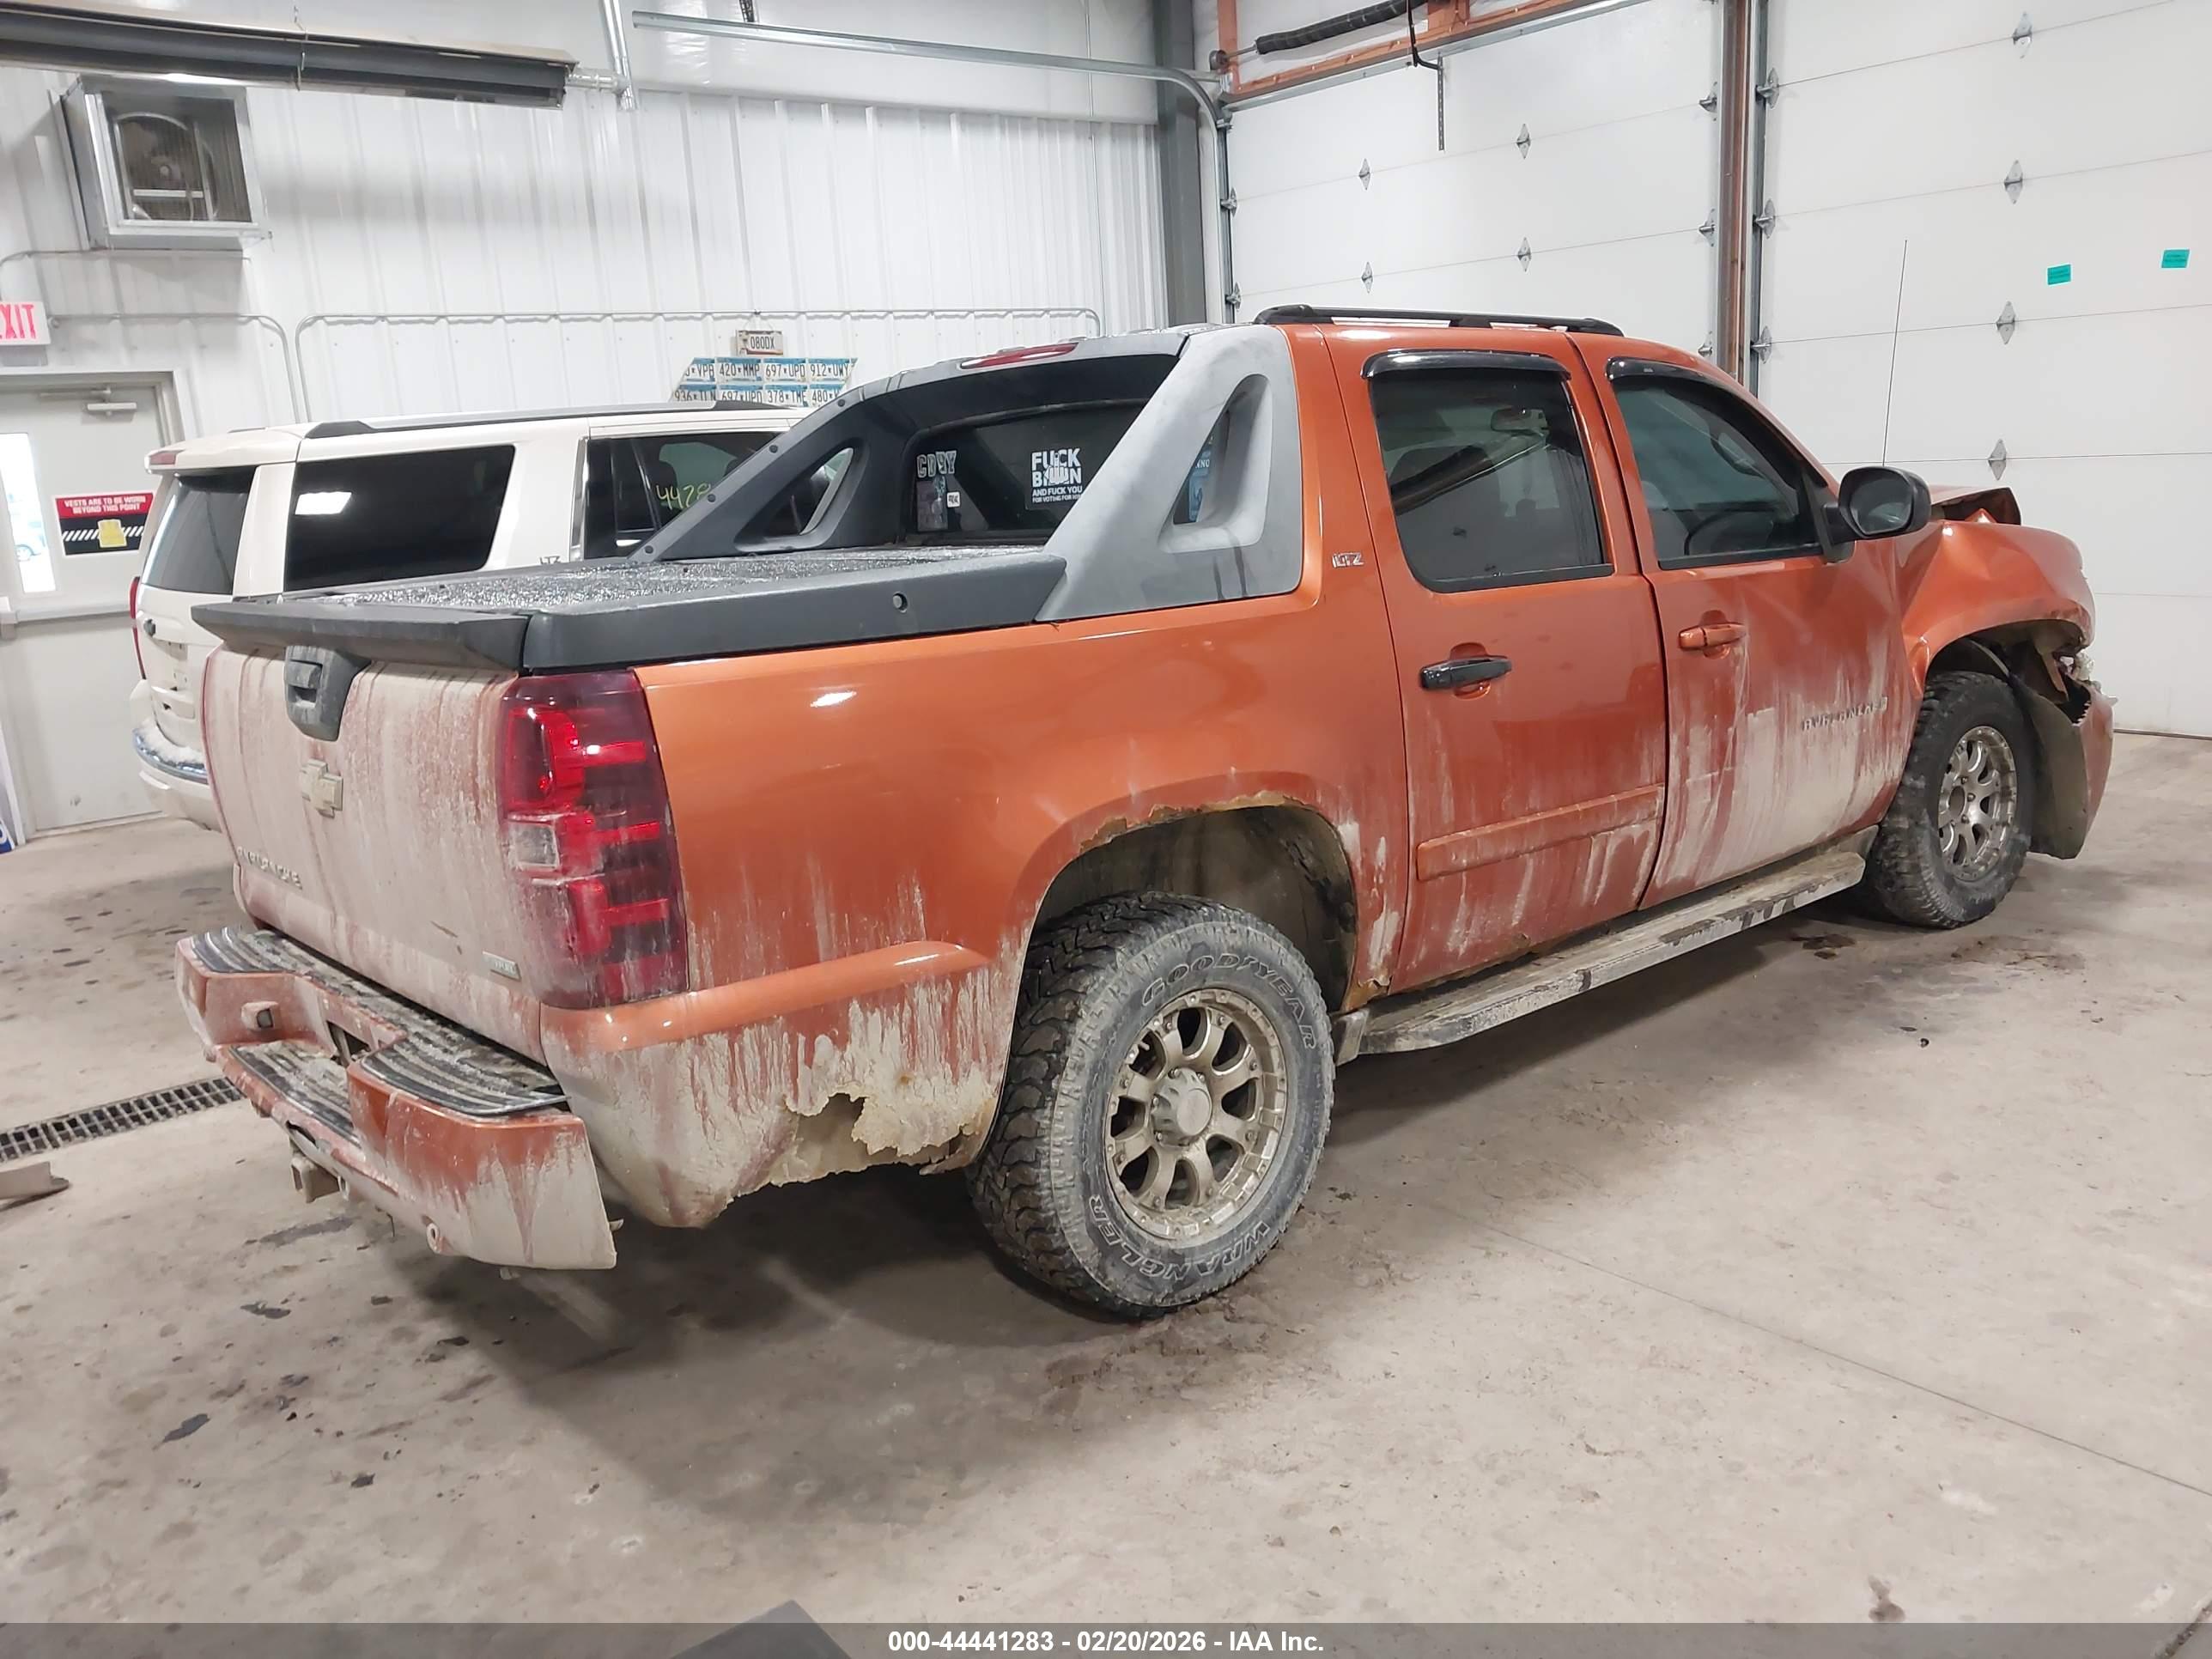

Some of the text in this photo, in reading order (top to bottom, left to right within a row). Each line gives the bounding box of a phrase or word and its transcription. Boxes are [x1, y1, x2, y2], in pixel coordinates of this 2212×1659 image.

[0, 304, 36, 339] XIT
[1031, 447, 1081, 471] FUCK
[1032, 467, 1082, 487] BIN
[1032, 485, 1083, 497] AND FUCK YOU
[64, 499, 88, 507] VESTS
[102, 504, 118, 513] THIS
[1141, 952, 1317, 1050] GOODYEAR
[1089, 1194, 1271, 1281] WRANGLER
